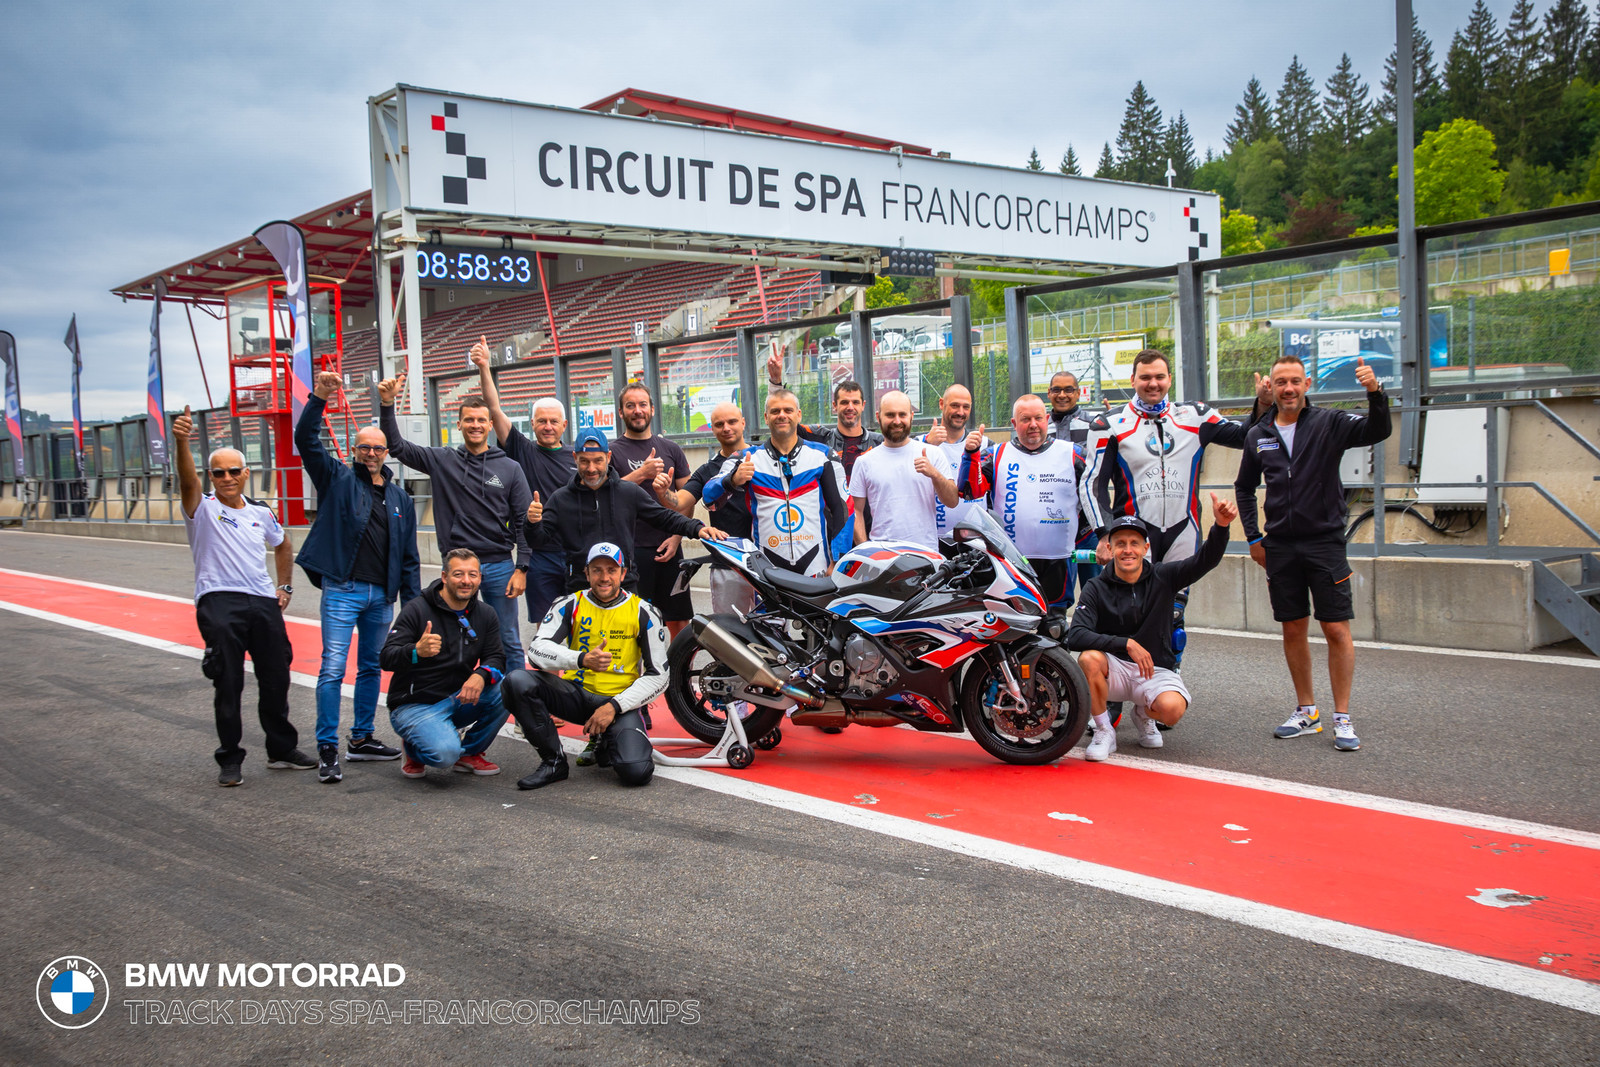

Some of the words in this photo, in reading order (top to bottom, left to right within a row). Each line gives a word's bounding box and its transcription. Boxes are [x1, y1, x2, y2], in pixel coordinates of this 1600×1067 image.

[538, 141, 714, 203] CIRCUIT
[728, 162, 780, 209] DE
[794, 171, 866, 218] SPA
[416, 250, 531, 283] 08:58:33
[580, 409, 614, 428] BigMat
[1145, 466, 1178, 479] BOXER
[1140, 480, 1184, 493] EVASION
[779, 533, 814, 542] Location
[534, 650, 557, 660] Motorrad
